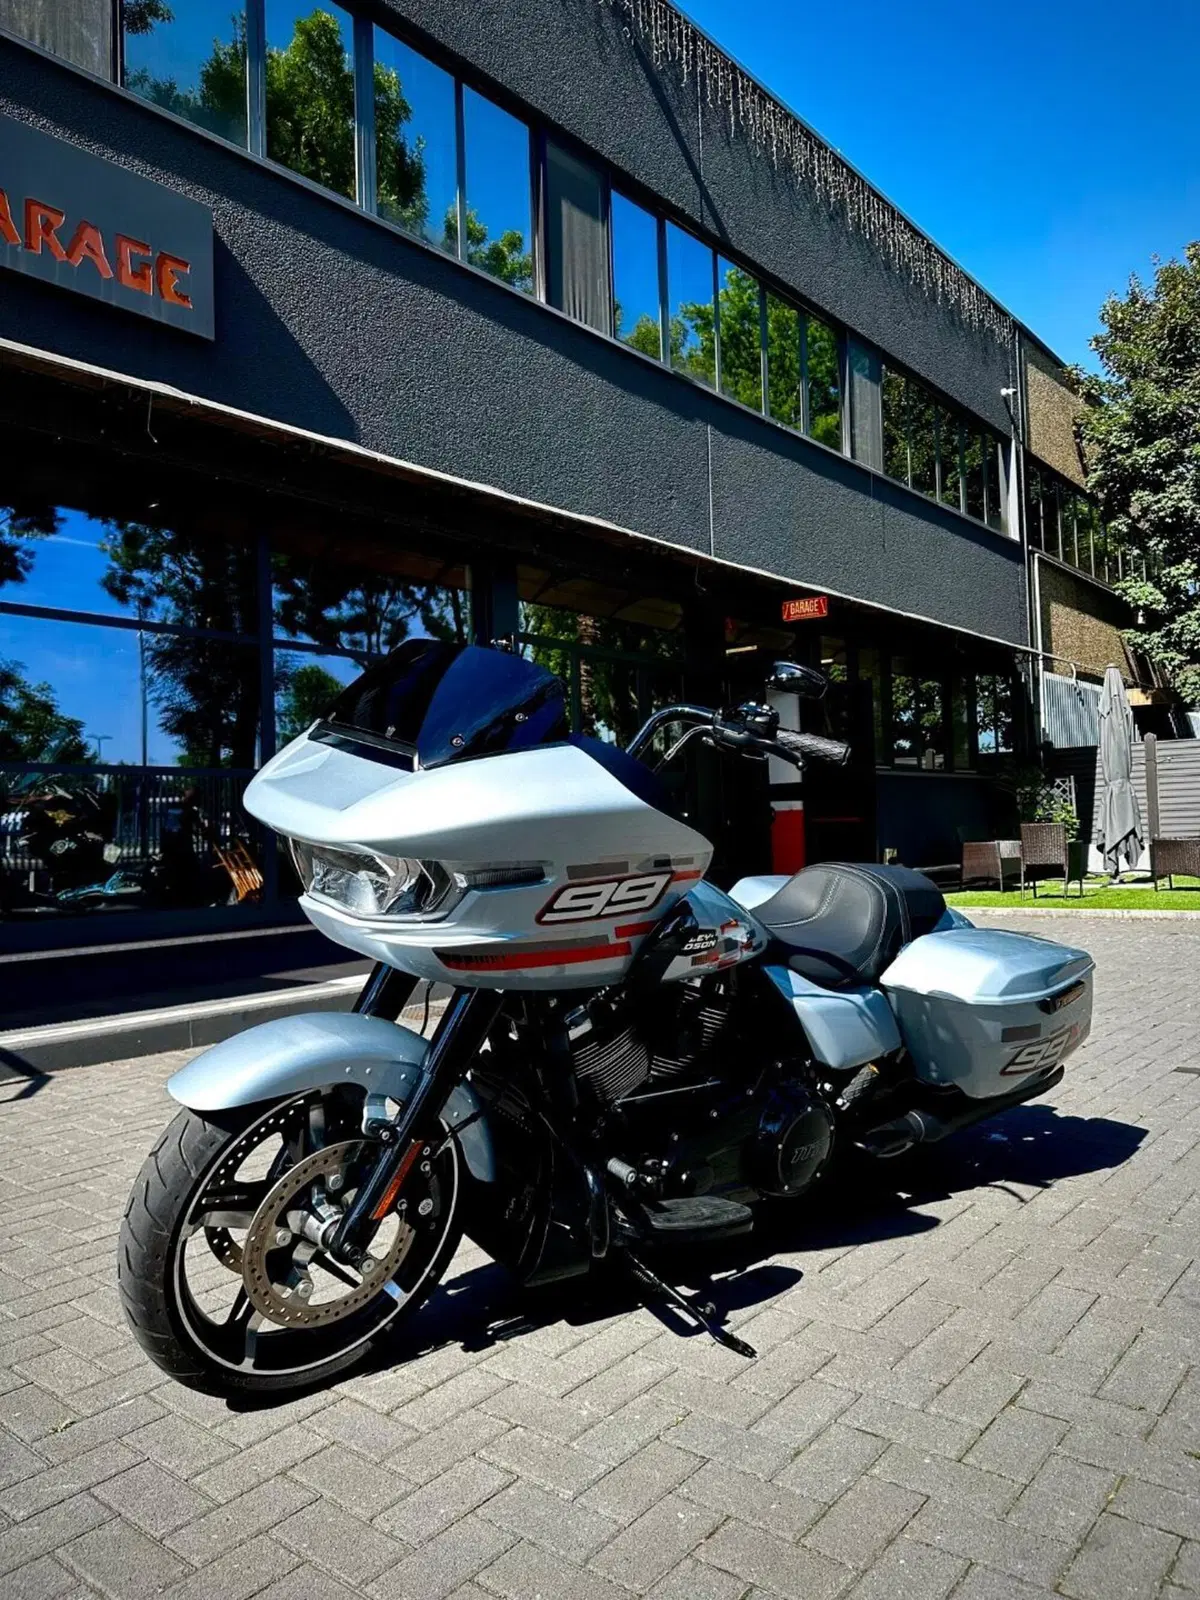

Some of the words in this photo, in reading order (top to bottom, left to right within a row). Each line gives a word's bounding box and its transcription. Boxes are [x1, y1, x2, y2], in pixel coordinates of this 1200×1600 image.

[790, 599, 819, 615] GARAGE
[540, 872, 674, 922] 99
[1001, 1030, 1072, 1075] 99
